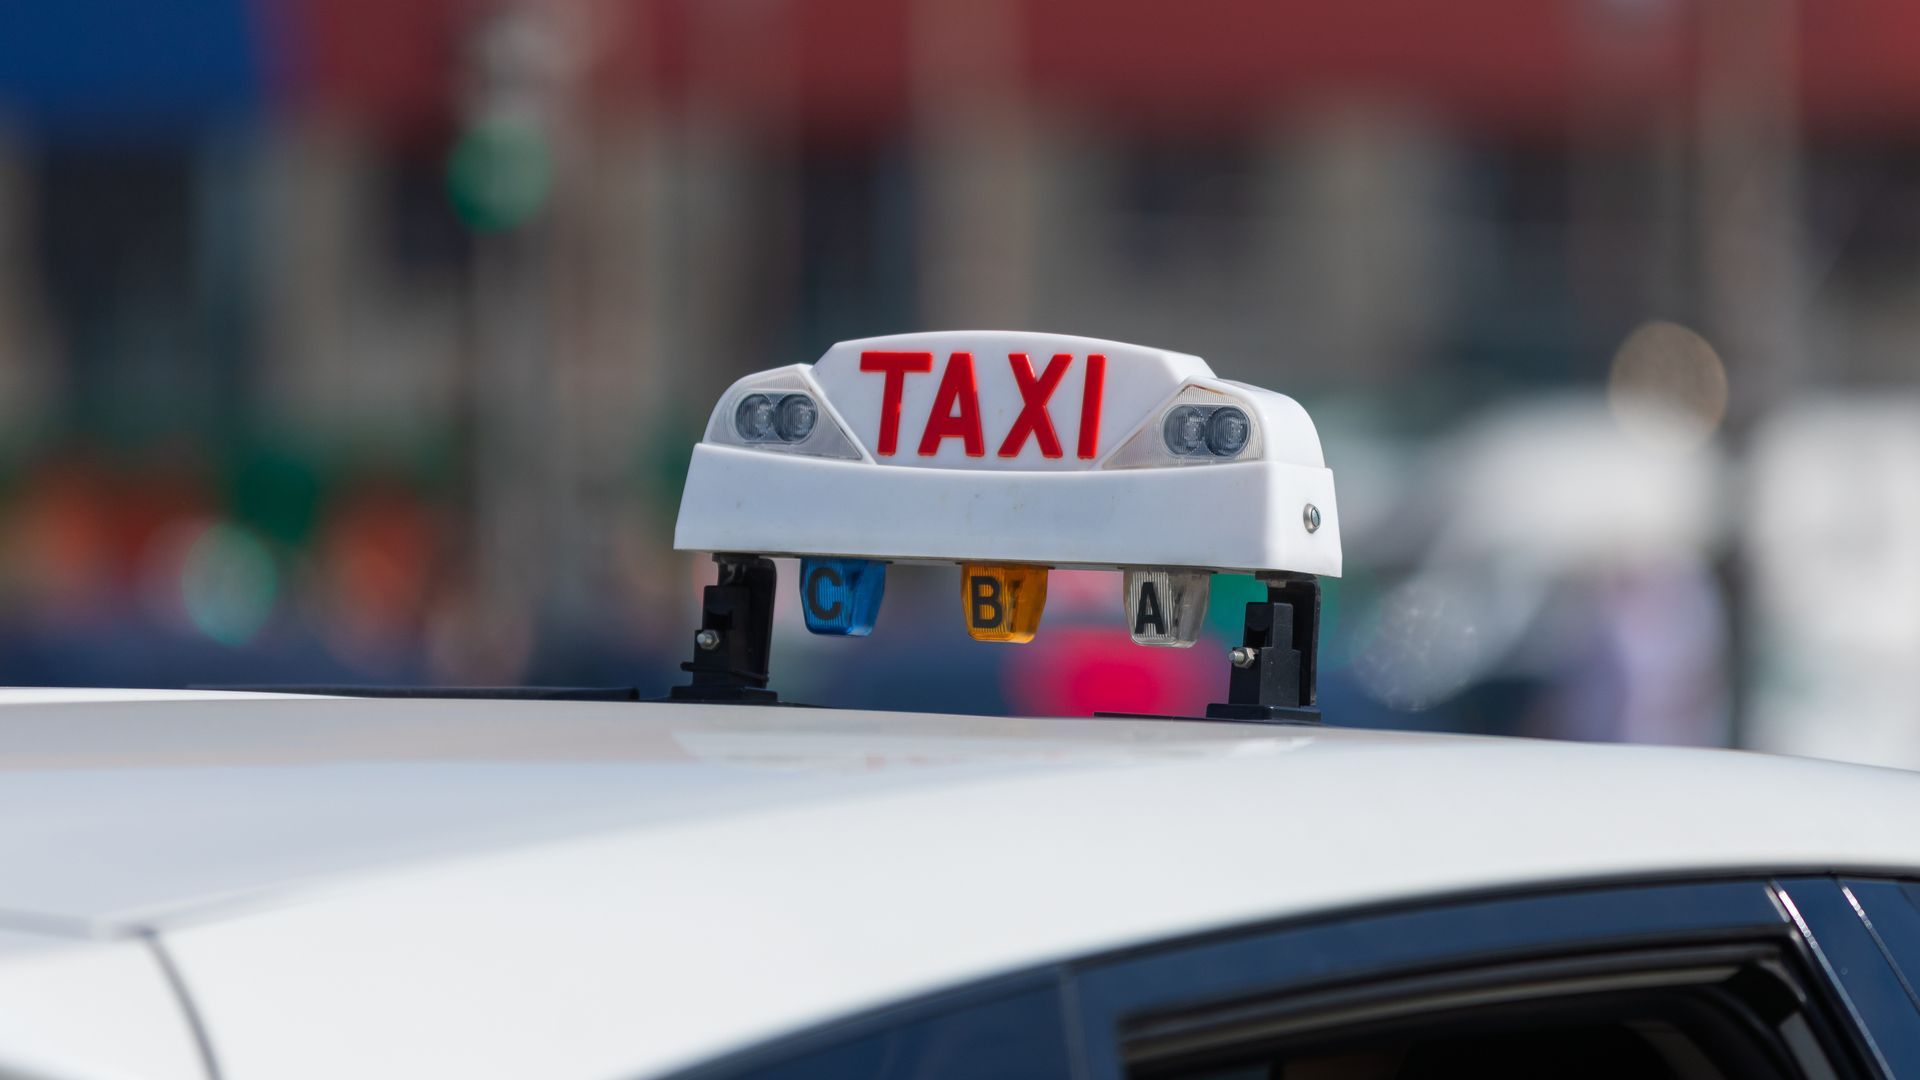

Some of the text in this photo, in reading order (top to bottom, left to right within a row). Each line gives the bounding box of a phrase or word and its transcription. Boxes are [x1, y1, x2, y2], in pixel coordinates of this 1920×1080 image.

[859, 351, 1106, 460] TAXI
[807, 568, 841, 620] C
[971, 576, 1002, 628] B
[1135, 581, 1166, 635] A
